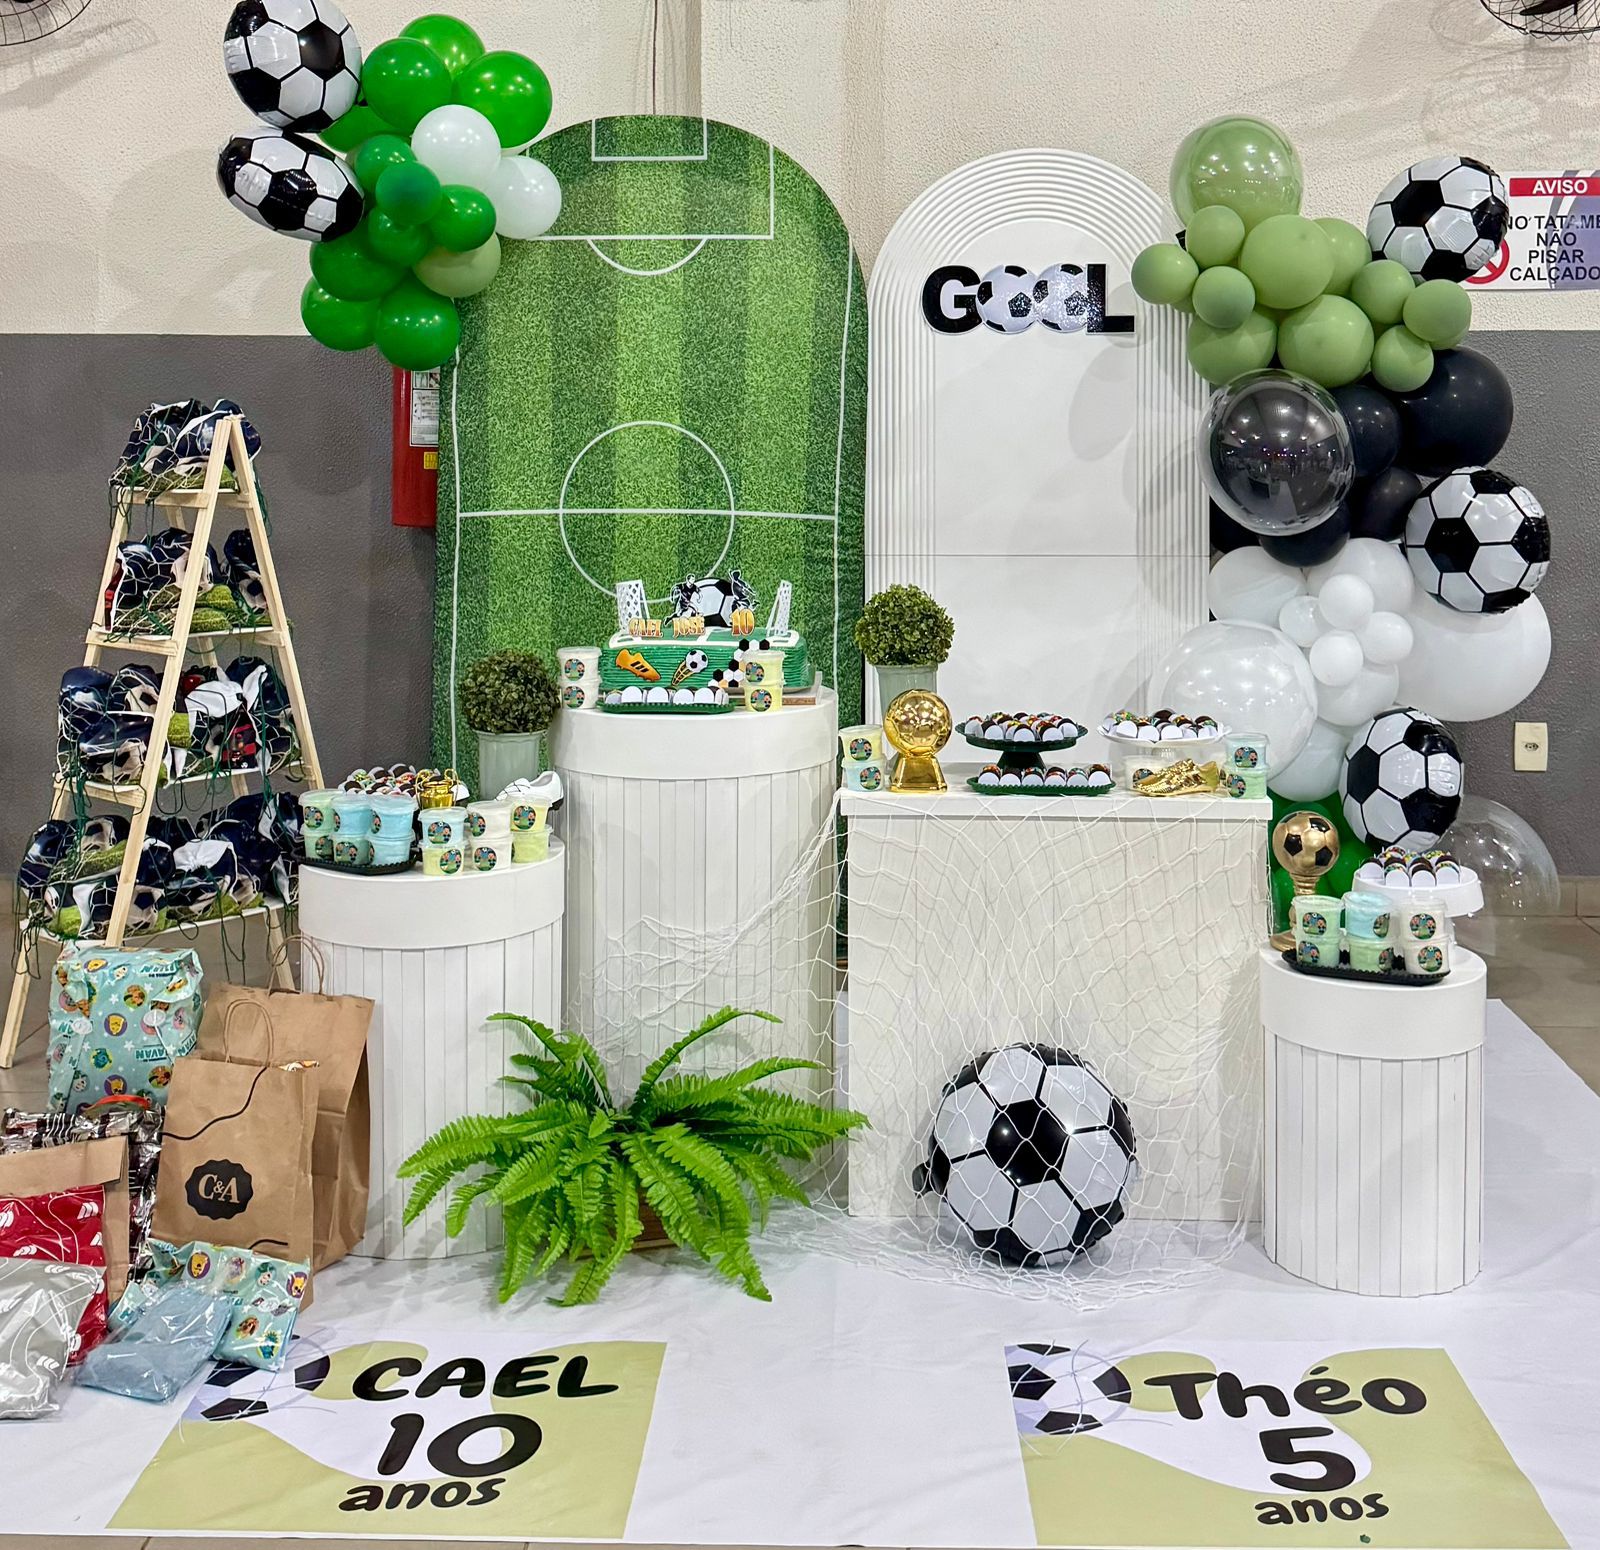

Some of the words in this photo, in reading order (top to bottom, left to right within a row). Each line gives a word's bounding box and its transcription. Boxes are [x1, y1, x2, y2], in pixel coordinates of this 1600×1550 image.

[1532, 179, 1588, 194] AVISO
[1536, 229, 1577, 246] NÃO
[1528, 249, 1584, 264] PISAR
[1510, 266, 1600, 284] CALÇADO
[922, 263, 1135, 333] GOOL
[629, 617, 663, 638] CAEL
[730, 608, 755, 636] 10
[136, 1049, 167, 1059] AVAN
[198, 1173, 240, 1204] C&A
[352, 1355, 619, 1401] CAEL
[1144, 1366, 1427, 1420] Théo
[377, 1413, 542, 1477] 10
[1259, 1426, 1356, 1492] 5
[338, 1478, 506, 1511] anos
[1254, 1493, 1389, 1525] anos
